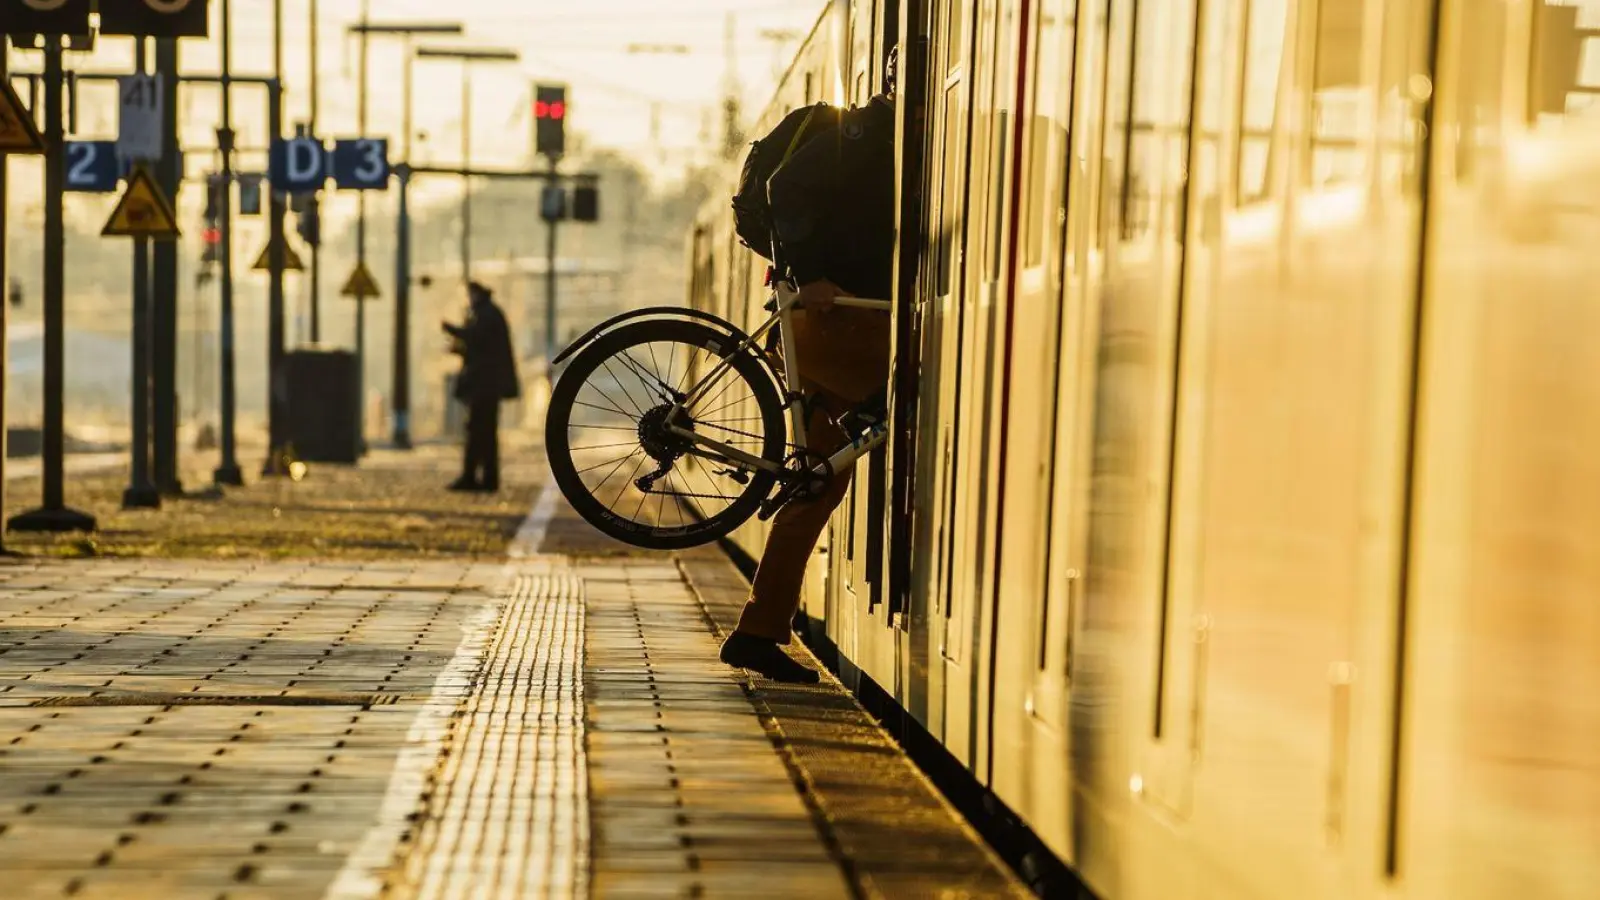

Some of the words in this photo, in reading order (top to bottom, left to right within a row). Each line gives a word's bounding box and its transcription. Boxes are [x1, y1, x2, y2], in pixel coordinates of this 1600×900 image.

[125, 80, 156, 109] 41
[67, 143, 97, 183] 2
[287, 139, 320, 181] D
[355, 139, 384, 182] 3
